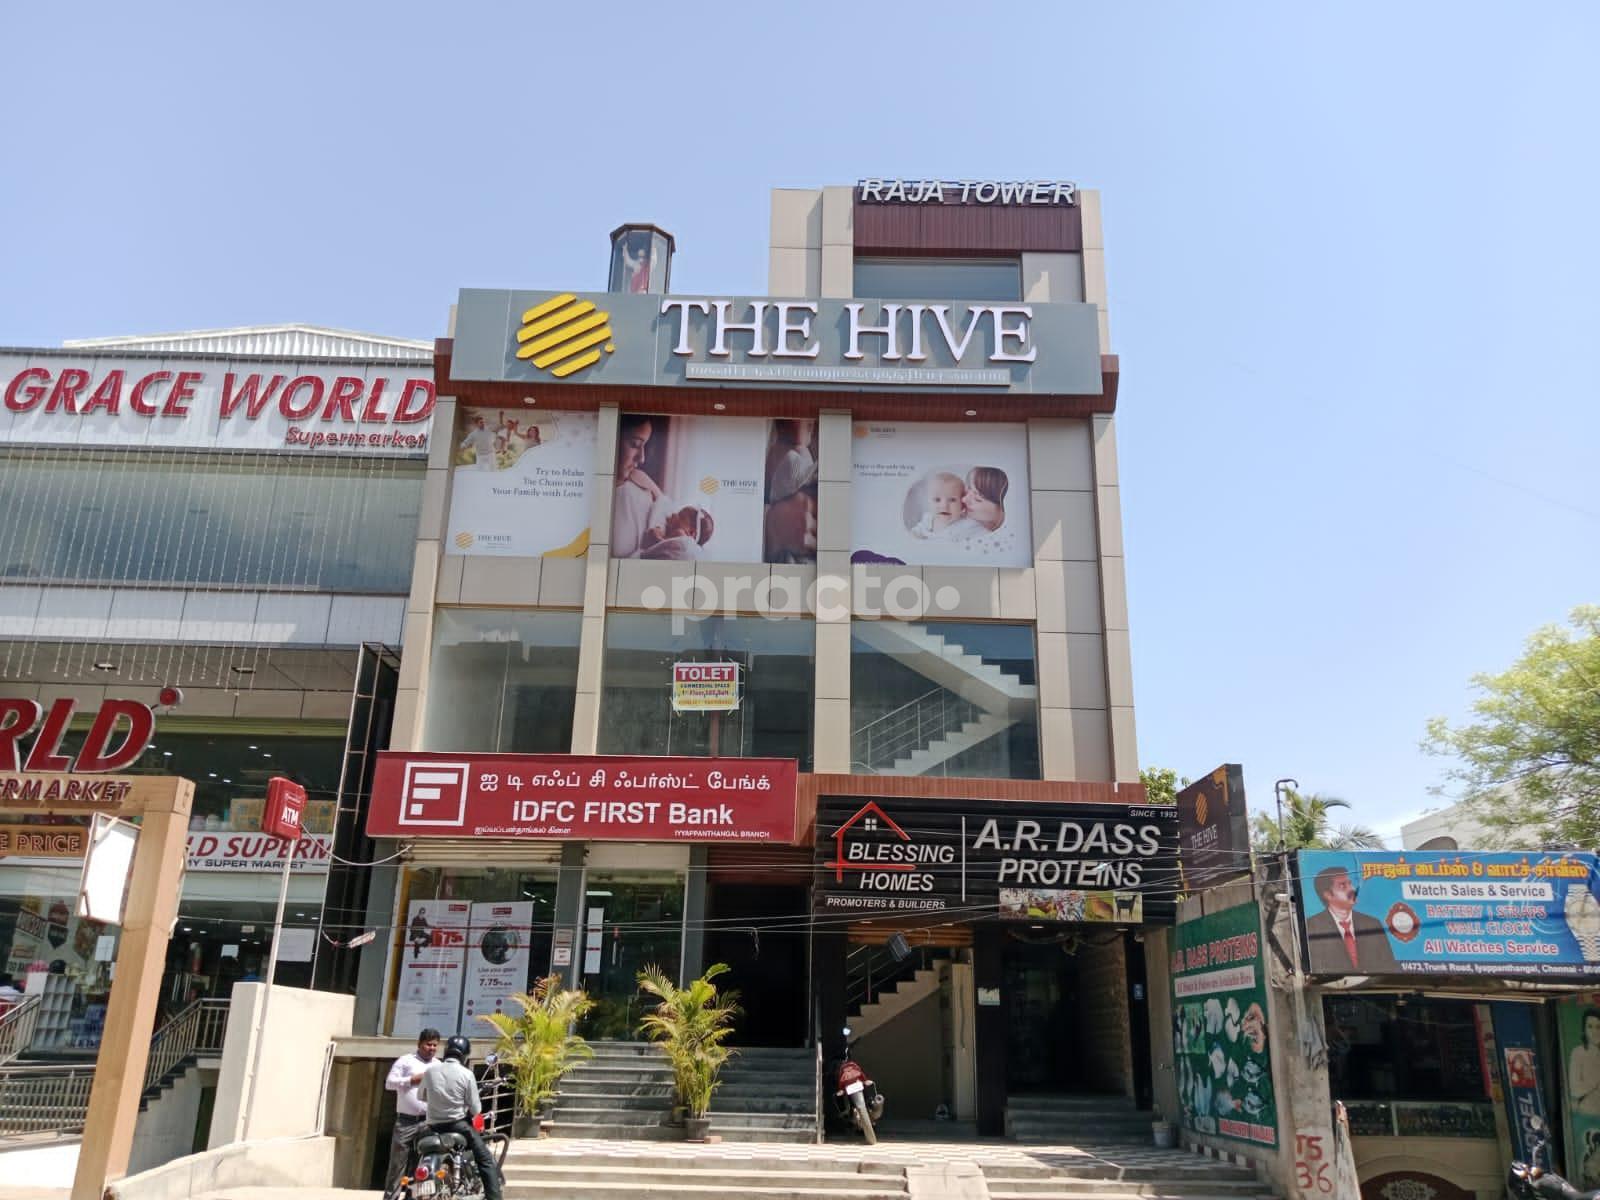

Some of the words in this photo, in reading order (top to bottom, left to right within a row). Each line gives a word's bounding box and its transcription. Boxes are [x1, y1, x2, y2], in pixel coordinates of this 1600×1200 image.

[861, 179, 944, 202] RAJA
[959, 180, 1075, 204] TOWER
[661, 299, 820, 357] THE
[844, 303, 1037, 362] HIVE
[4, 367, 205, 418] GRACE
[218, 373, 437, 424] WORLD
[287, 426, 427, 448] Supermarket
[492, 487, 512, 495] Your
[514, 487, 540, 497] Family
[678, 667, 732, 680] TOLET
[480, 773, 499, 792] ஐ
[507, 774, 525, 792] டி
[589, 769, 606, 788] சி
[707, 771, 770, 790] பேங்க்
[282, 806, 299, 826] ATM
[512, 800, 576, 823] IDFC
[583, 801, 661, 824] FIRST
[668, 803, 734, 825] Bank
[1130, 809, 1156, 818] SINCE
[16, 833, 81, 852] PRICE
[1055, 821, 1162, 856] DASS
[848, 842, 955, 863] BLESSING
[205, 860, 248, 868] SUPER
[998, 858, 1144, 887] PROTEINS
[860, 872, 935, 892] HOMES
[1408, 884, 1447, 897] Watch
[1451, 884, 1483, 897] Sales
[1487, 884, 1497, 897] &
[1500, 884, 1546, 898] Service
[827, 897, 887, 908] PROMOTERS
[889, 899, 896, 908] &
[898, 900, 945, 910] BUILDERS
[1486, 921, 1533, 935] CLOCK
[1424, 940, 1442, 953] All
[1446, 940, 1504, 954] Watches
[1506, 940, 1559, 955] Service
